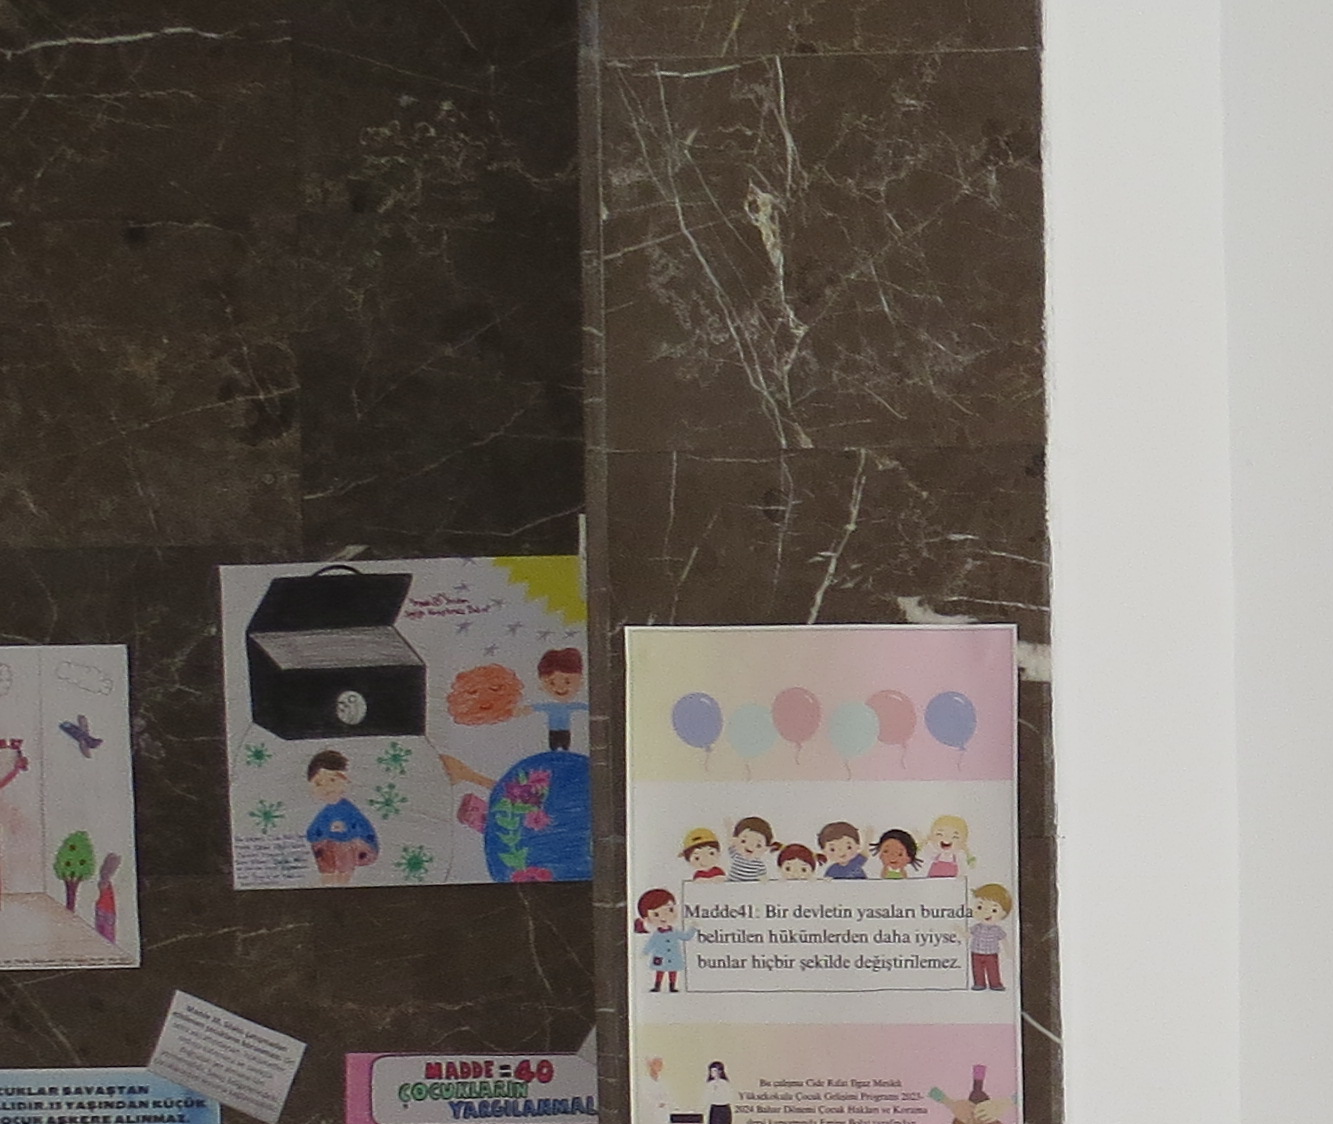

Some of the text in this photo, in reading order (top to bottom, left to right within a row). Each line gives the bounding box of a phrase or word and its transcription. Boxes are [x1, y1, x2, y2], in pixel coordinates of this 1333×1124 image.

[684, 903, 974, 923] Madde41: Bir devletin yasaları burada
[693, 927, 962, 948] belirtilen hükümlerden daha iyiyse,
[697, 953, 962, 973] bunlar hiçbir şekilde değiştirilemez.
[424, 1061, 494, 1080] MADDE
[62, 1085, 149, 1097] SAVAŞTAN
[399, 1081, 529, 1109] ÇOCUKLARIN
[66, 1098, 207, 1112] YAŞINDAN KÜÇÜK
[47, 1114, 190, 1124] ASKERE ALINMAZ.
